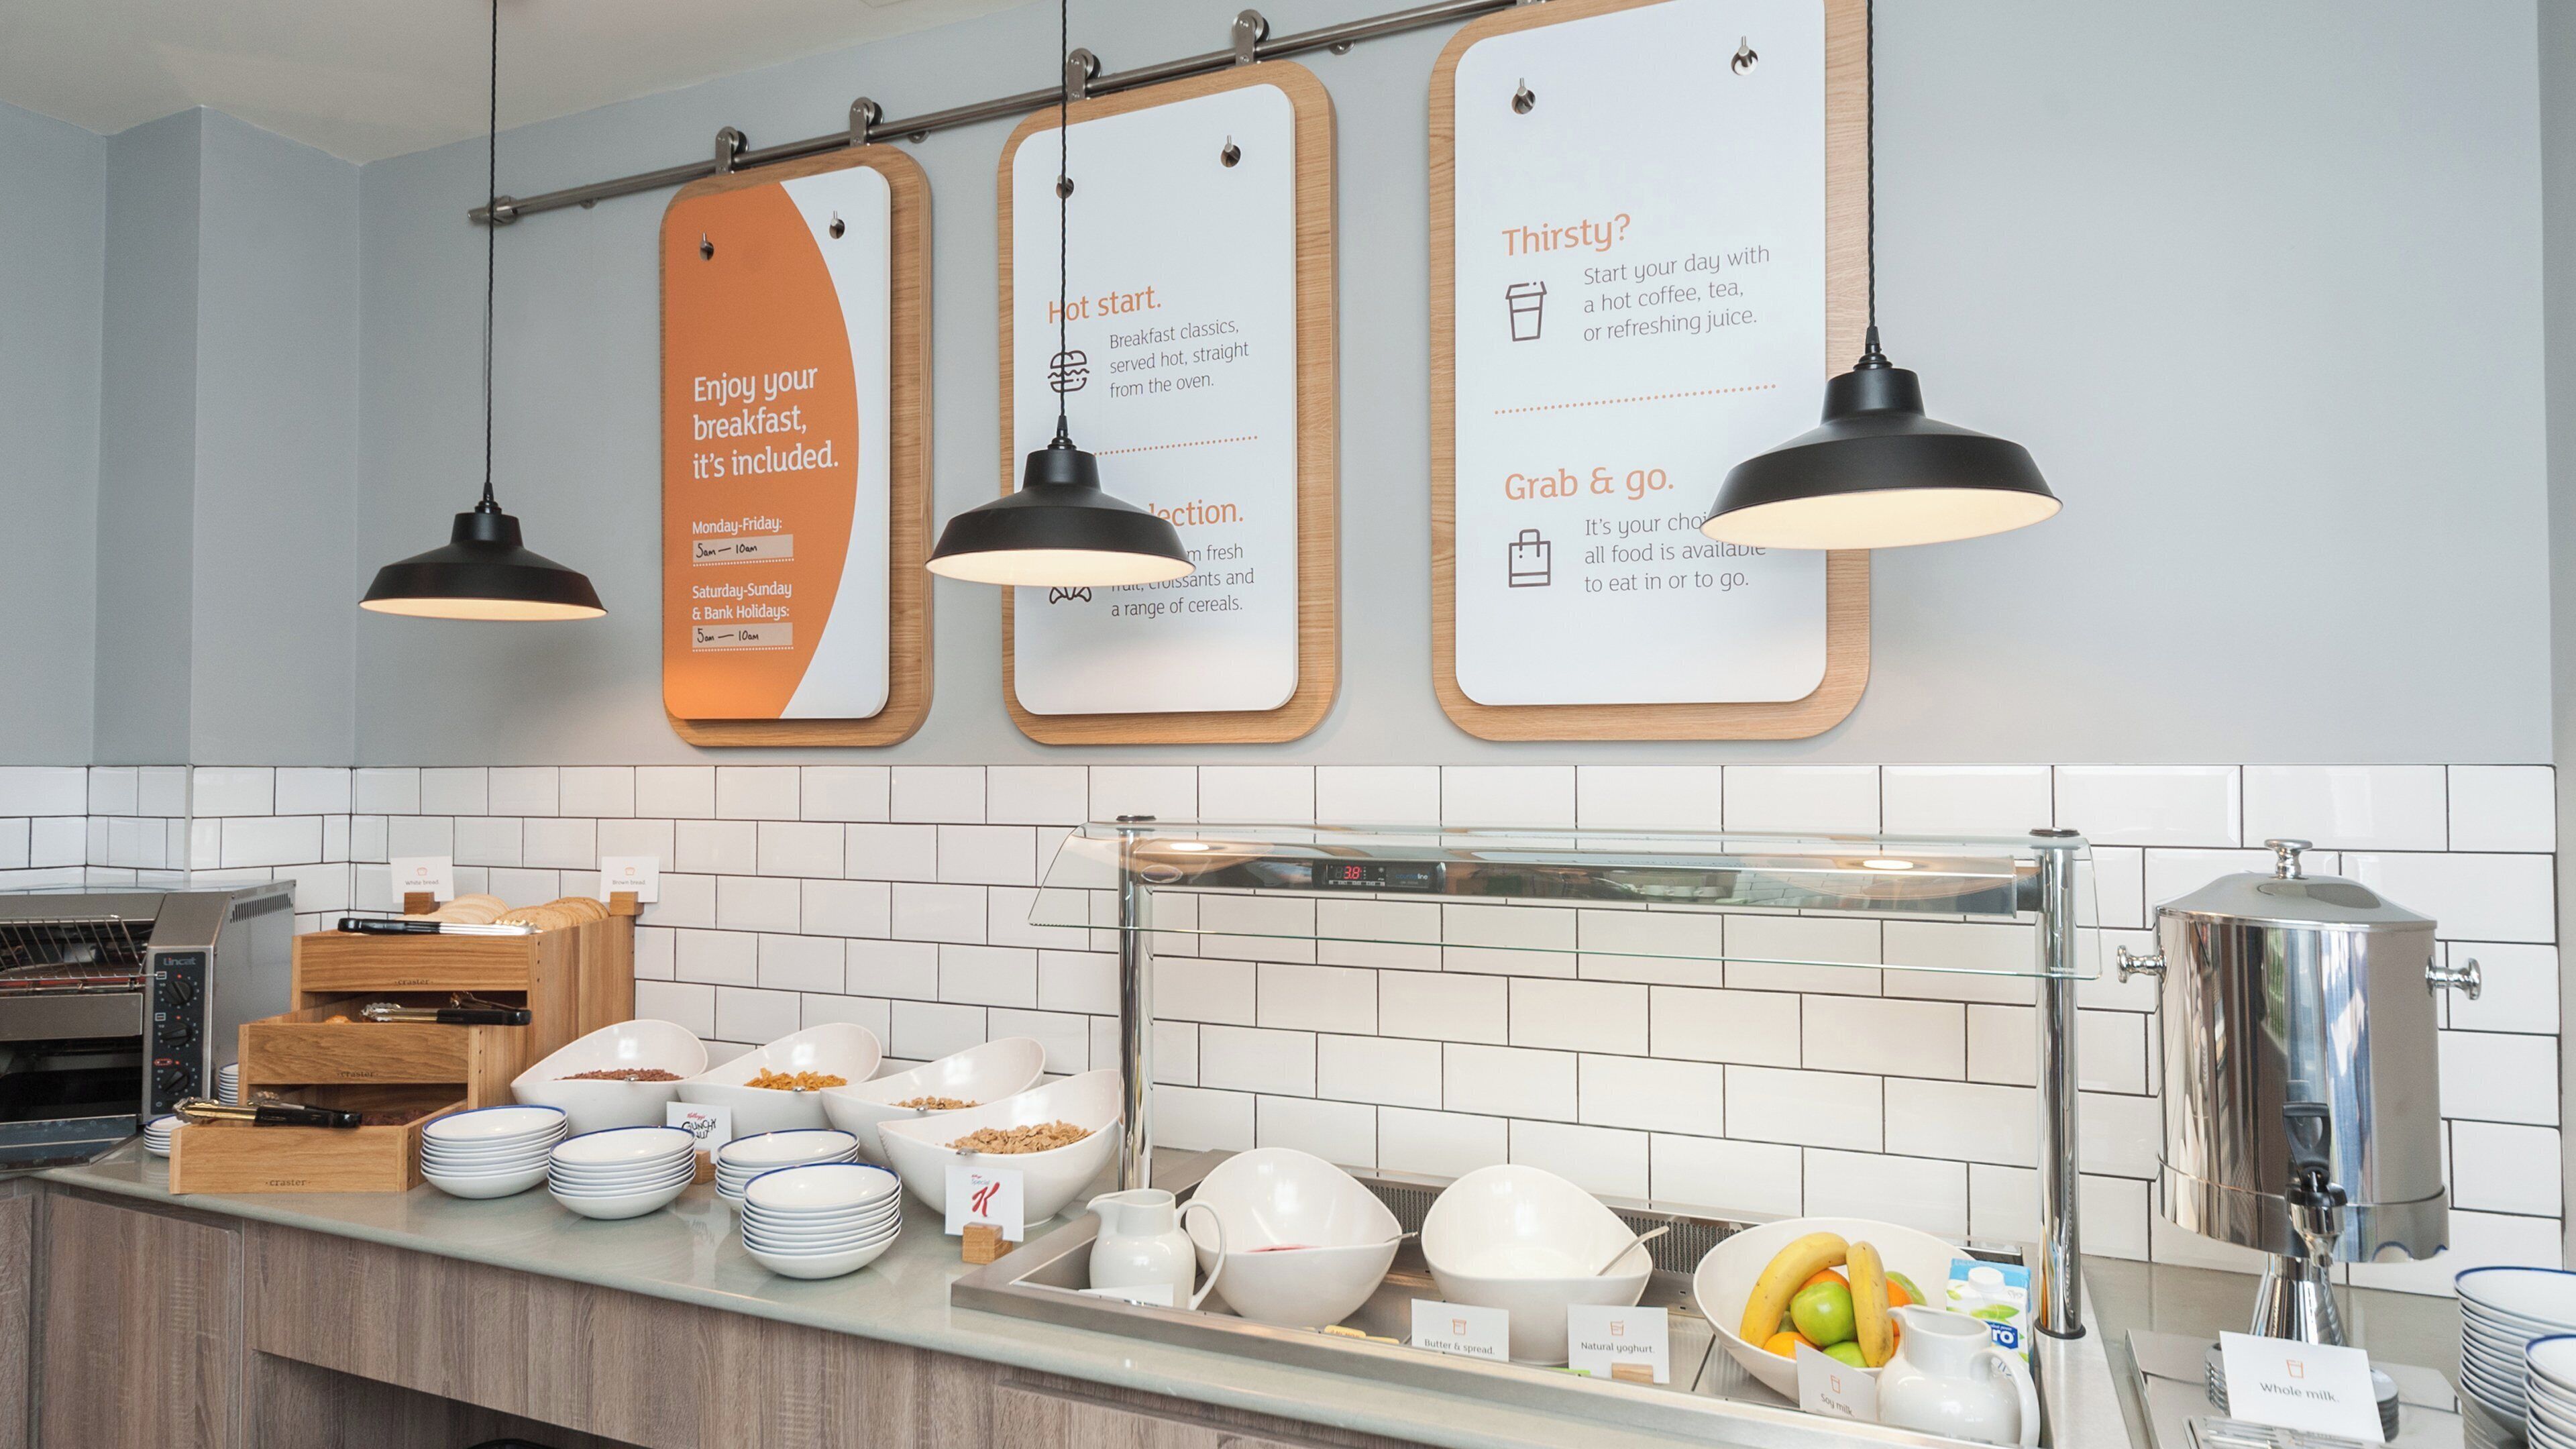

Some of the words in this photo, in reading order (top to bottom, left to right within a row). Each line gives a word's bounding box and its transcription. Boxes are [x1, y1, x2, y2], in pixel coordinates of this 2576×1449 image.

[1502, 213, 1631, 256] Thirsty?
[1584, 264, 1627, 284] Start
[1634, 260, 1677, 283] your
[1684, 254, 1720, 274] day
[1727, 245, 1770, 266] with
[1049, 296, 1089, 324] Hot
[1098, 286, 1162, 316] start.
[1584, 299, 1595, 313] a
[1602, 291, 1631, 311] hot
[1638, 286, 1701, 307] coffee,
[1709, 280, 1744, 299] tea,
[1110, 326, 1175, 350] Breakfast
[1181, 319, 1239, 340] classics,
[1584, 327, 1603, 341] or
[1608, 313, 1701, 339] refreshing
[1706, 308, 1758, 333] juice.
[1110, 354, 1155, 374] served
[1161, 350, 1188, 367] hot,
[1193, 341, 1250, 363] straight
[694, 373, 756, 407] Enjoy
[764, 368, 818, 401] your
[1110, 382, 1143, 398] from
[1148, 378, 1171, 393] the
[1177, 373, 1214, 390] oven.
[693, 405, 807, 441] breakfast,
[693, 453, 725, 480] it's
[732, 440, 839, 477] included.
[1505, 468, 1578, 500] Grab
[1590, 467, 1615, 494] &
[1626, 468, 1674, 500] go.
[1148, 499, 1244, 527] ection.
[692, 517, 783, 537] Monday-Friday:
[1585, 519, 1611, 536] It's
[1618, 518, 1661, 539] your
[1668, 512, 1707, 531] cho
[696, 543, 716, 558] 5am
[736, 543, 758, 555] 10am
[1207, 543, 1243, 560] fresh
[1585, 546, 1605, 564] all
[1611, 543, 1653, 563] food
[1661, 543, 1675, 561] is
[1226, 568, 1254, 585] and
[1585, 576, 1603, 592] to
[1609, 574, 1637, 592] eat
[1645, 573, 1662, 590] in
[1669, 574, 1687, 589] or
[1695, 572, 1713, 588] to
[1721, 572, 1750, 592] go.
[692, 582, 792, 601] Saturday-Sunday
[692, 607, 701, 621] &
[704, 605, 734, 620] Bank
[736, 602, 790, 621] Holidays:
[1112, 604, 1120, 616] a
[1124, 602, 1165, 619] range
[1170, 598, 1185, 612] of
[1188, 595, 1243, 612] cereals.
[696, 628, 714, 643] 5am
[738, 629, 760, 641] 10am
[163, 957, 197, 966] Lincat
[972, 1181, 1000, 1218] K
[1424, 1338, 1452, 1350] Butter
[1454, 1342, 1461, 1351] &
[1464, 1343, 1495, 1355] spread.
[1580, 1342, 1614, 1352] Natural
[1617, 1342, 1656, 1354] yoghurt.
[1821, 1393, 1835, 1409] Soy
[2259, 1382, 2302, 1397] Whole
[2306, 1390, 2339, 1403] milk.
